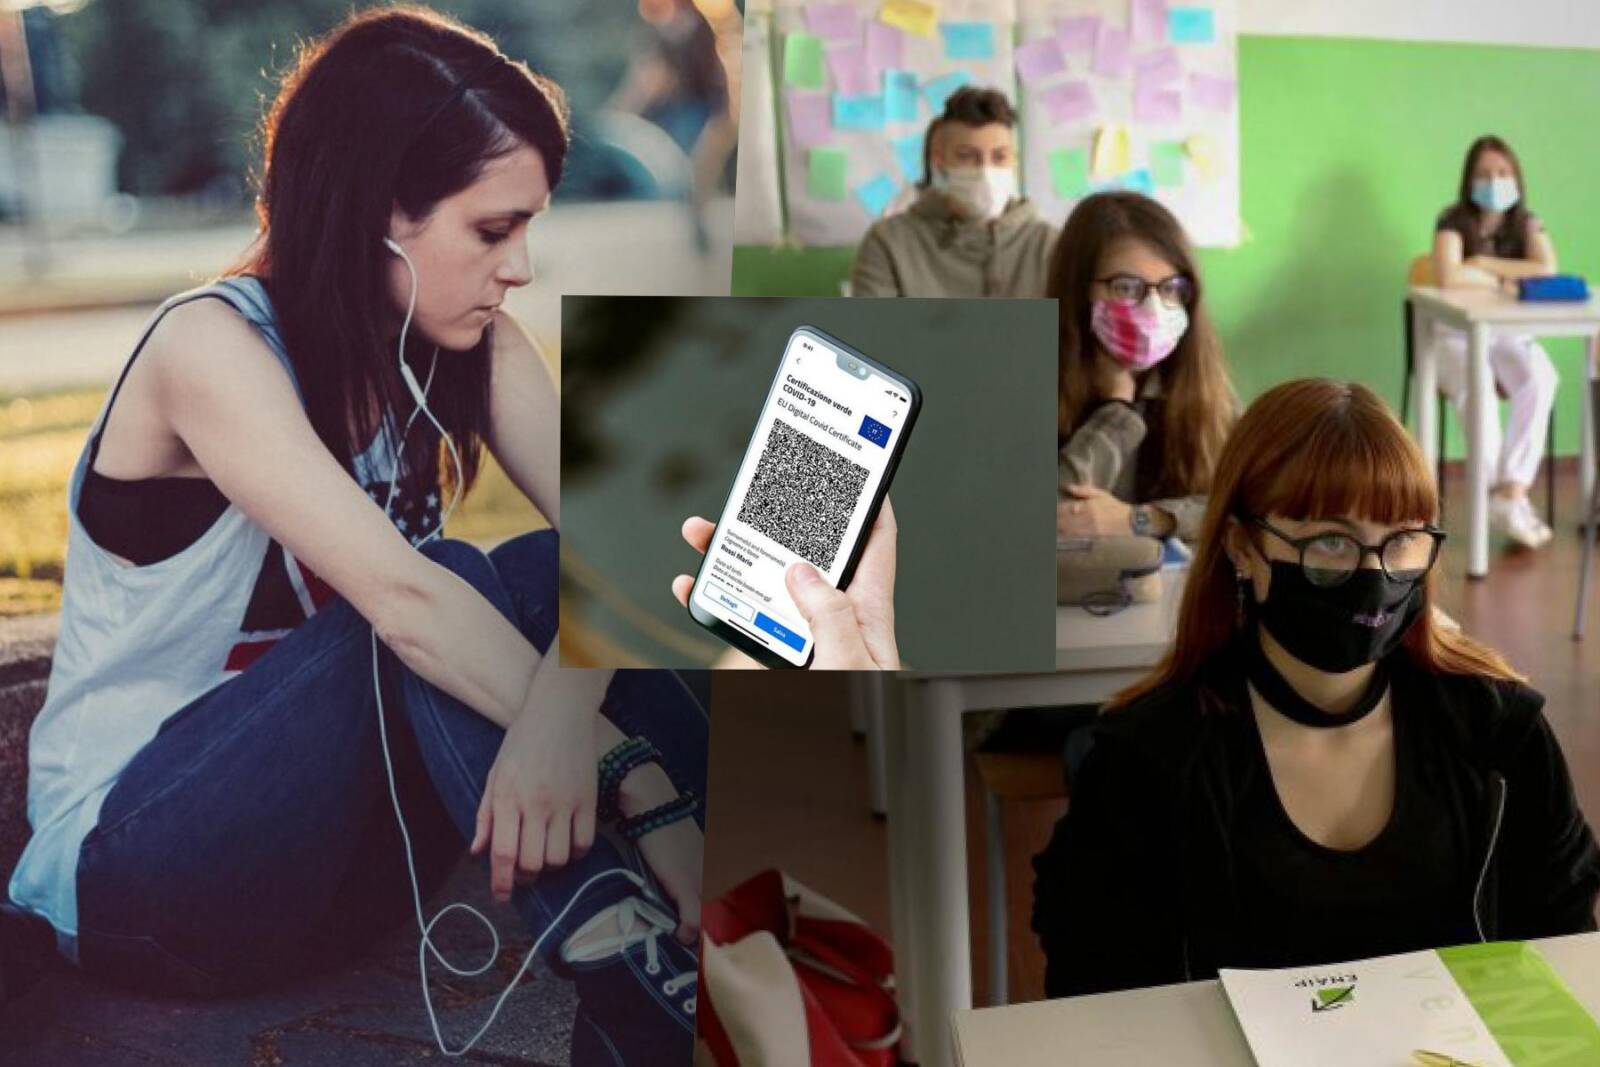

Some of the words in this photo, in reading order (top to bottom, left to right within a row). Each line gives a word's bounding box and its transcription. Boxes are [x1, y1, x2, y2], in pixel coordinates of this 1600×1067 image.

[782, 384, 817, 408] COVID-19
[786, 374, 832, 405] Certificazione
[832, 399, 853, 416] verde
[777, 397, 788, 409] EU
[788, 403, 810, 420] Digital
[809, 414, 829, 431] Covid
[828, 423, 863, 451] Certificate
[720, 543, 736, 557] Rossi
[736, 552, 753, 567] Mario
